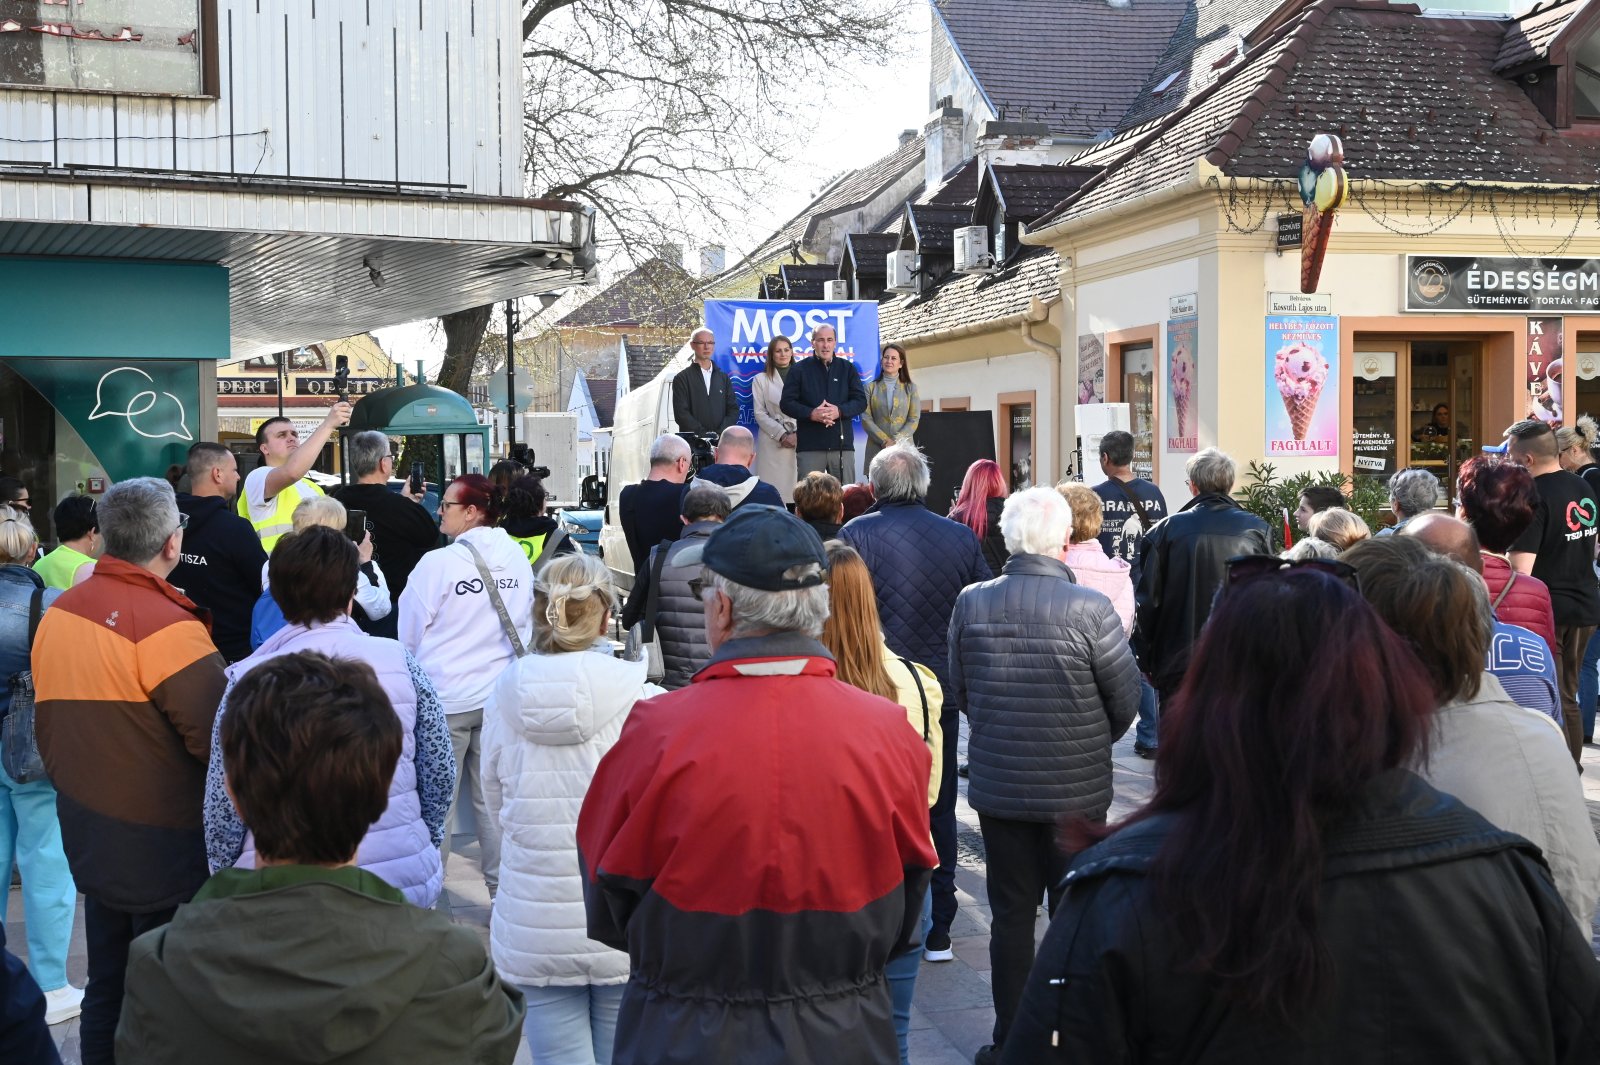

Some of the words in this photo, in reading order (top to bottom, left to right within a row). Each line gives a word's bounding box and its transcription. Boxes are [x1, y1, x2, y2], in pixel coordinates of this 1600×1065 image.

[1279, 233, 1300, 241] FAGYLALT
[1467, 293, 1529, 305] SÜTEMÉNYEK
[1536, 295, 1573, 305] TORTÁK
[1580, 297, 1600, 305] FAG
[1273, 302, 1297, 311] Kossuth
[1298, 303, 1313, 314] Lajos
[731, 308, 853, 343] MOST
[1269, 322, 1303, 330] HELYBEN
[1168, 437, 1197, 449] FAGYLALT
[1271, 440, 1332, 451] FAGYLALT
[1357, 458, 1383, 467] NYITVA
[180, 553, 208, 566] TISZA
[506, 627, 521, 650] FILA
